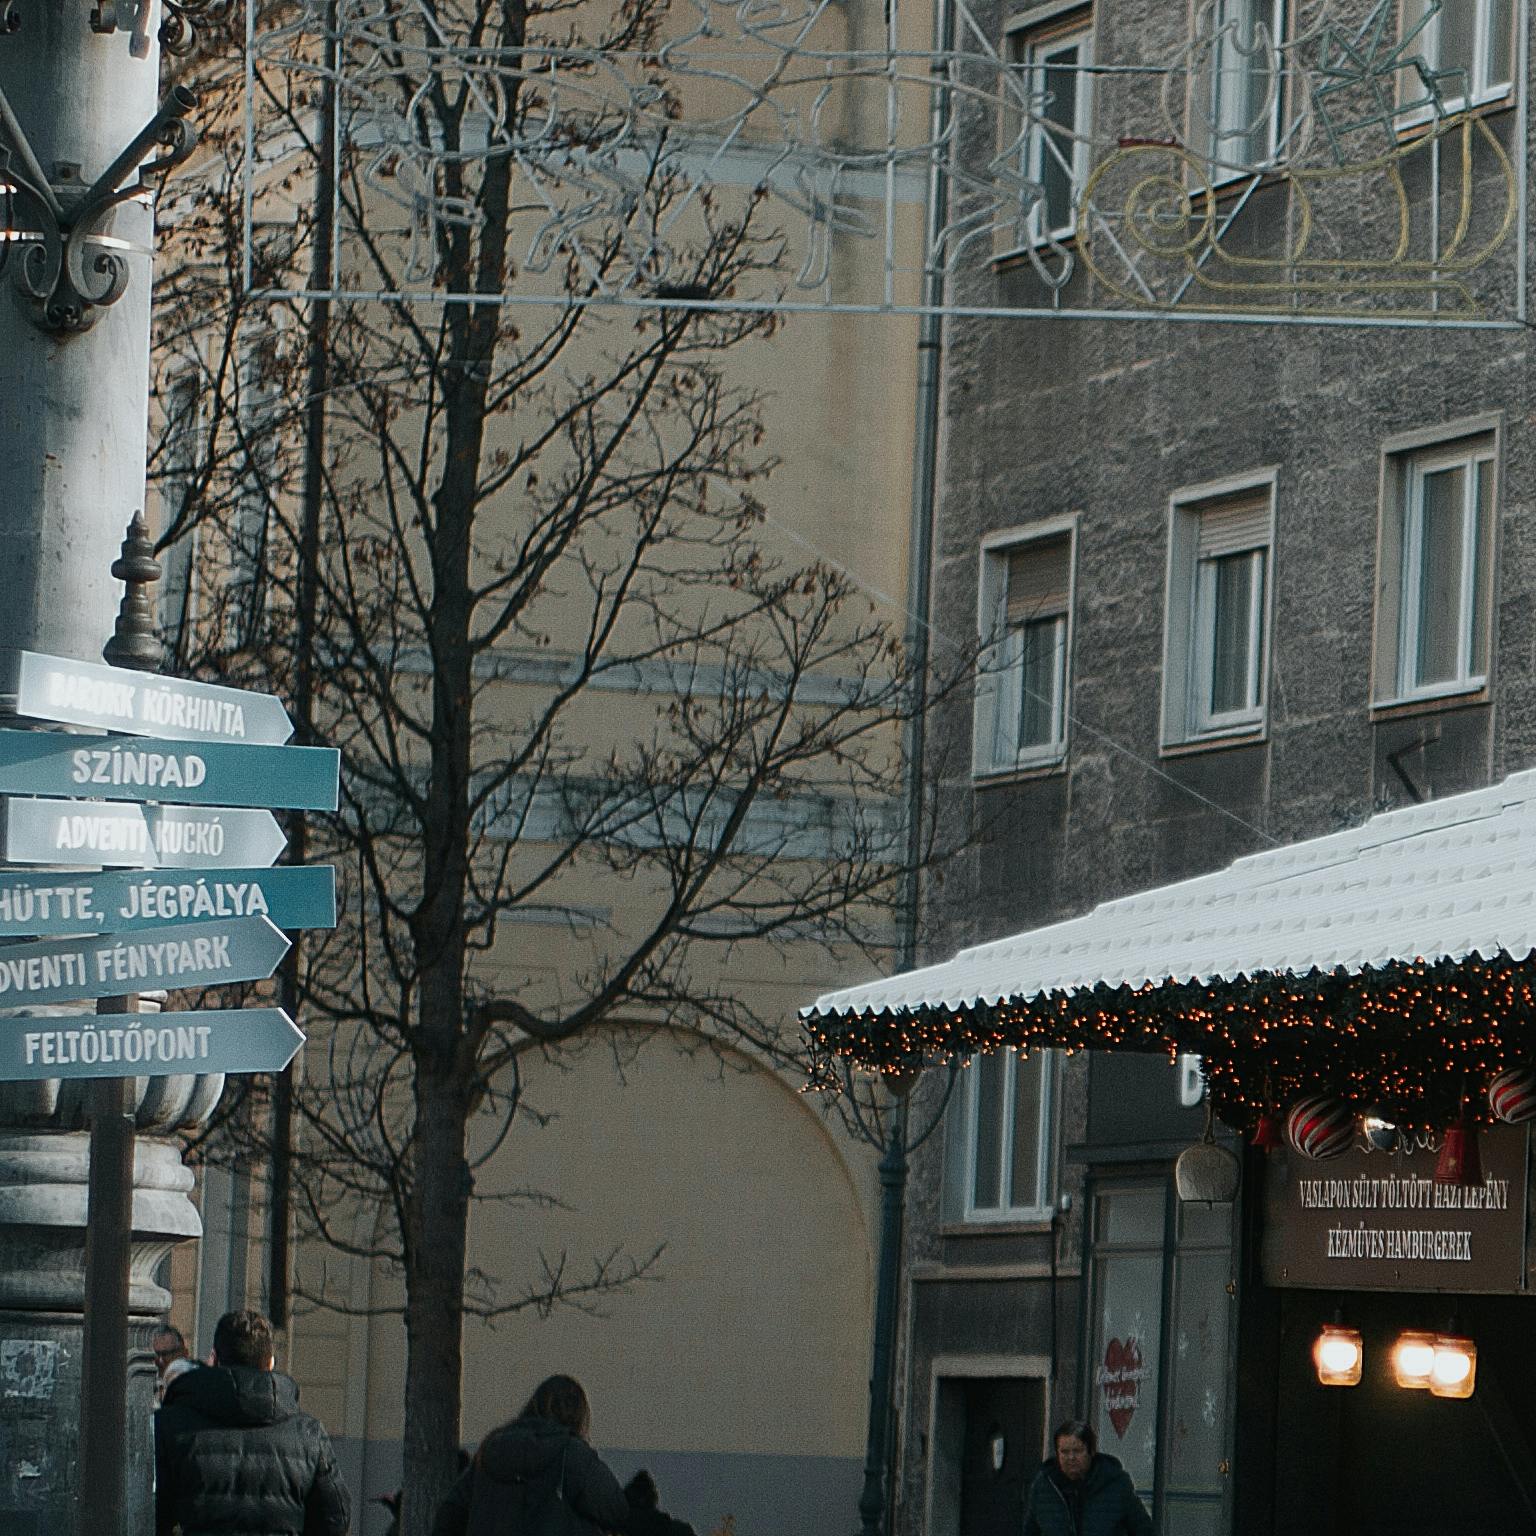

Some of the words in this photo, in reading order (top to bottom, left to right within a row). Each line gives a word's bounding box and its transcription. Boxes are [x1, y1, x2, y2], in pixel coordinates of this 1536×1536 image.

[142, 686, 245, 737] KÖRHINTA
[72, 746, 206, 787] SZÍNPAD
[56, 816, 147, 852] ADVENTI
[156, 817, 224, 856] KUCKÓ
[120, 879, 269, 919] JÉGPÁLYA
[98, 935, 232, 982] FÉNYPARK
[25, 1021, 212, 1065] FELTÖLTŐPONT
[1300, 1180, 1351, 1208] VASLAPON
[1352, 1173, 1380, 1208] SÜLT
[1381, 1173, 1432, 1208] TÖLTÖTT
[1328, 1221, 1384, 1258] KÉZMŰVES
[1386, 1230, 1472, 1260] HAMBURGEREK
